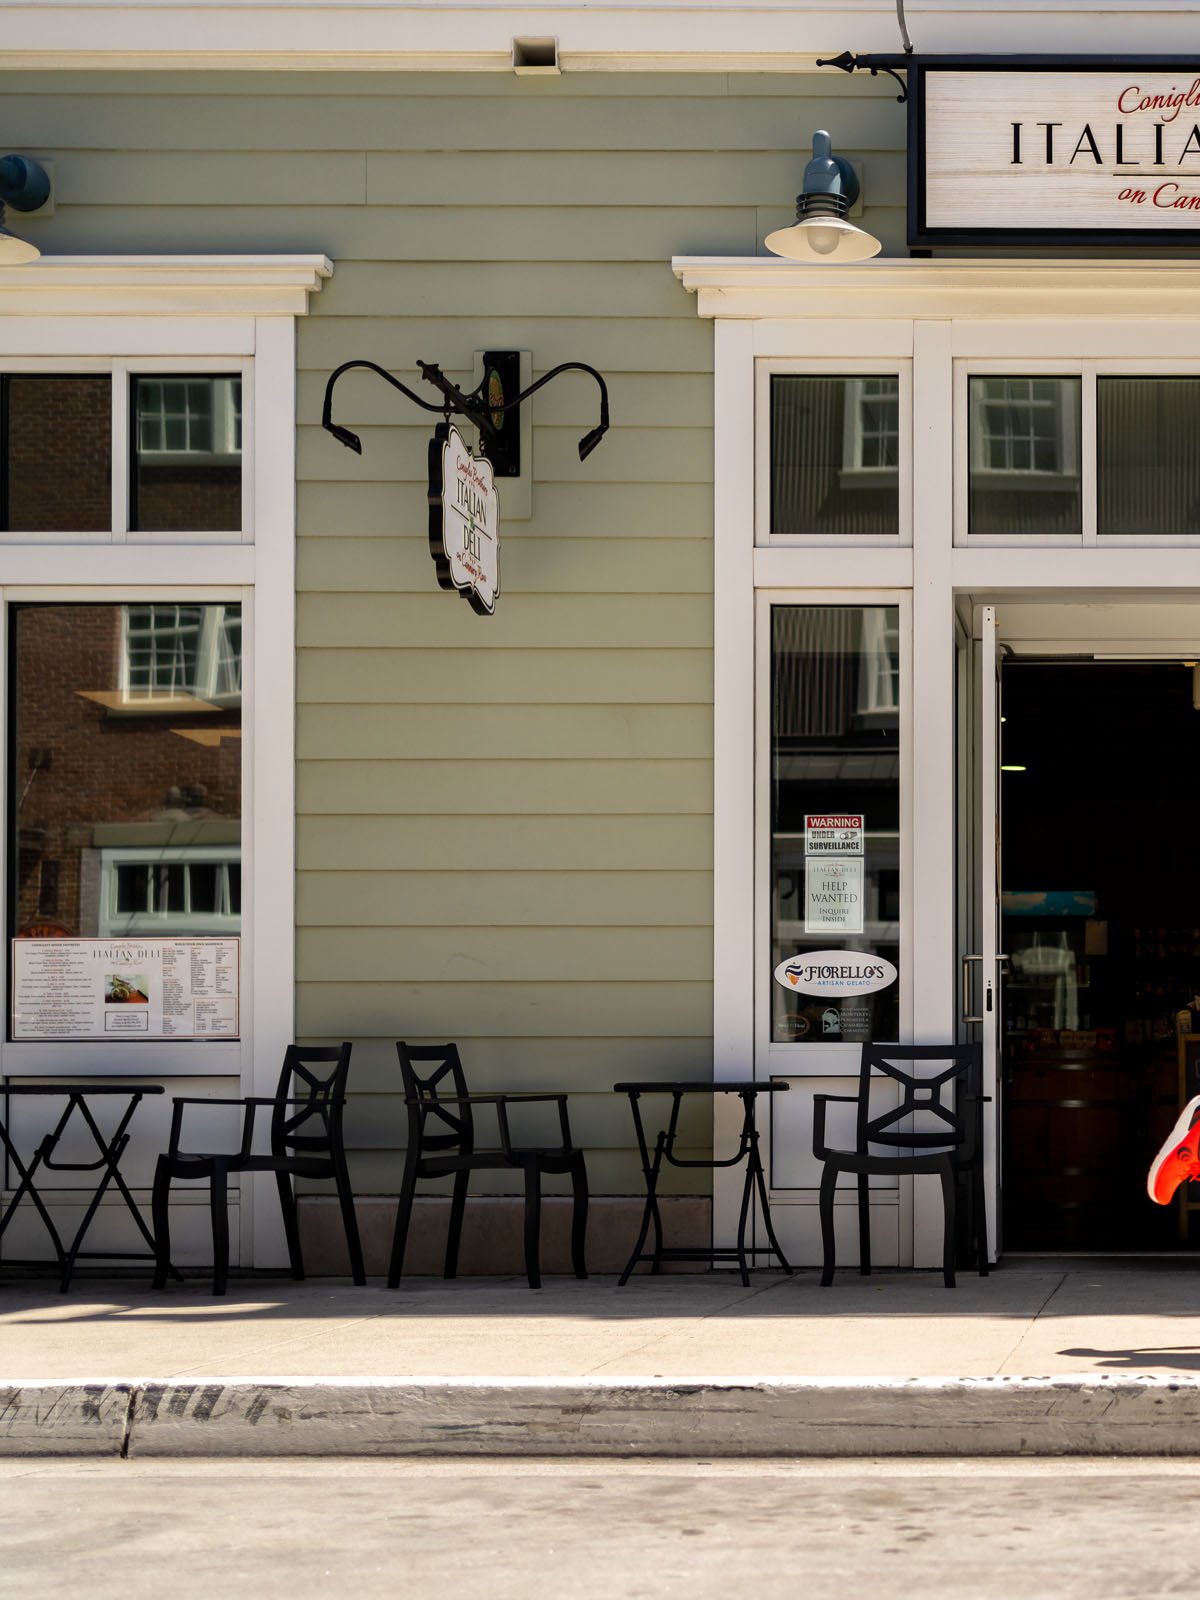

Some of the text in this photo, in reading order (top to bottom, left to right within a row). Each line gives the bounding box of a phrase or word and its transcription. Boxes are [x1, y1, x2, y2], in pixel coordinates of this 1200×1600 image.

[1118, 188, 1147, 204] on
[457, 477, 487, 527] ITALIAN
[463, 524, 481, 561] DELI
[810, 817, 860, 828] WARNING
[811, 831, 835, 839] UNDER
[808, 841, 860, 850] SURVEILLANCE
[821, 881, 848, 891] HELP
[811, 893, 858, 903] WANTED
[804, 965, 885, 982] FIORELLO'S
